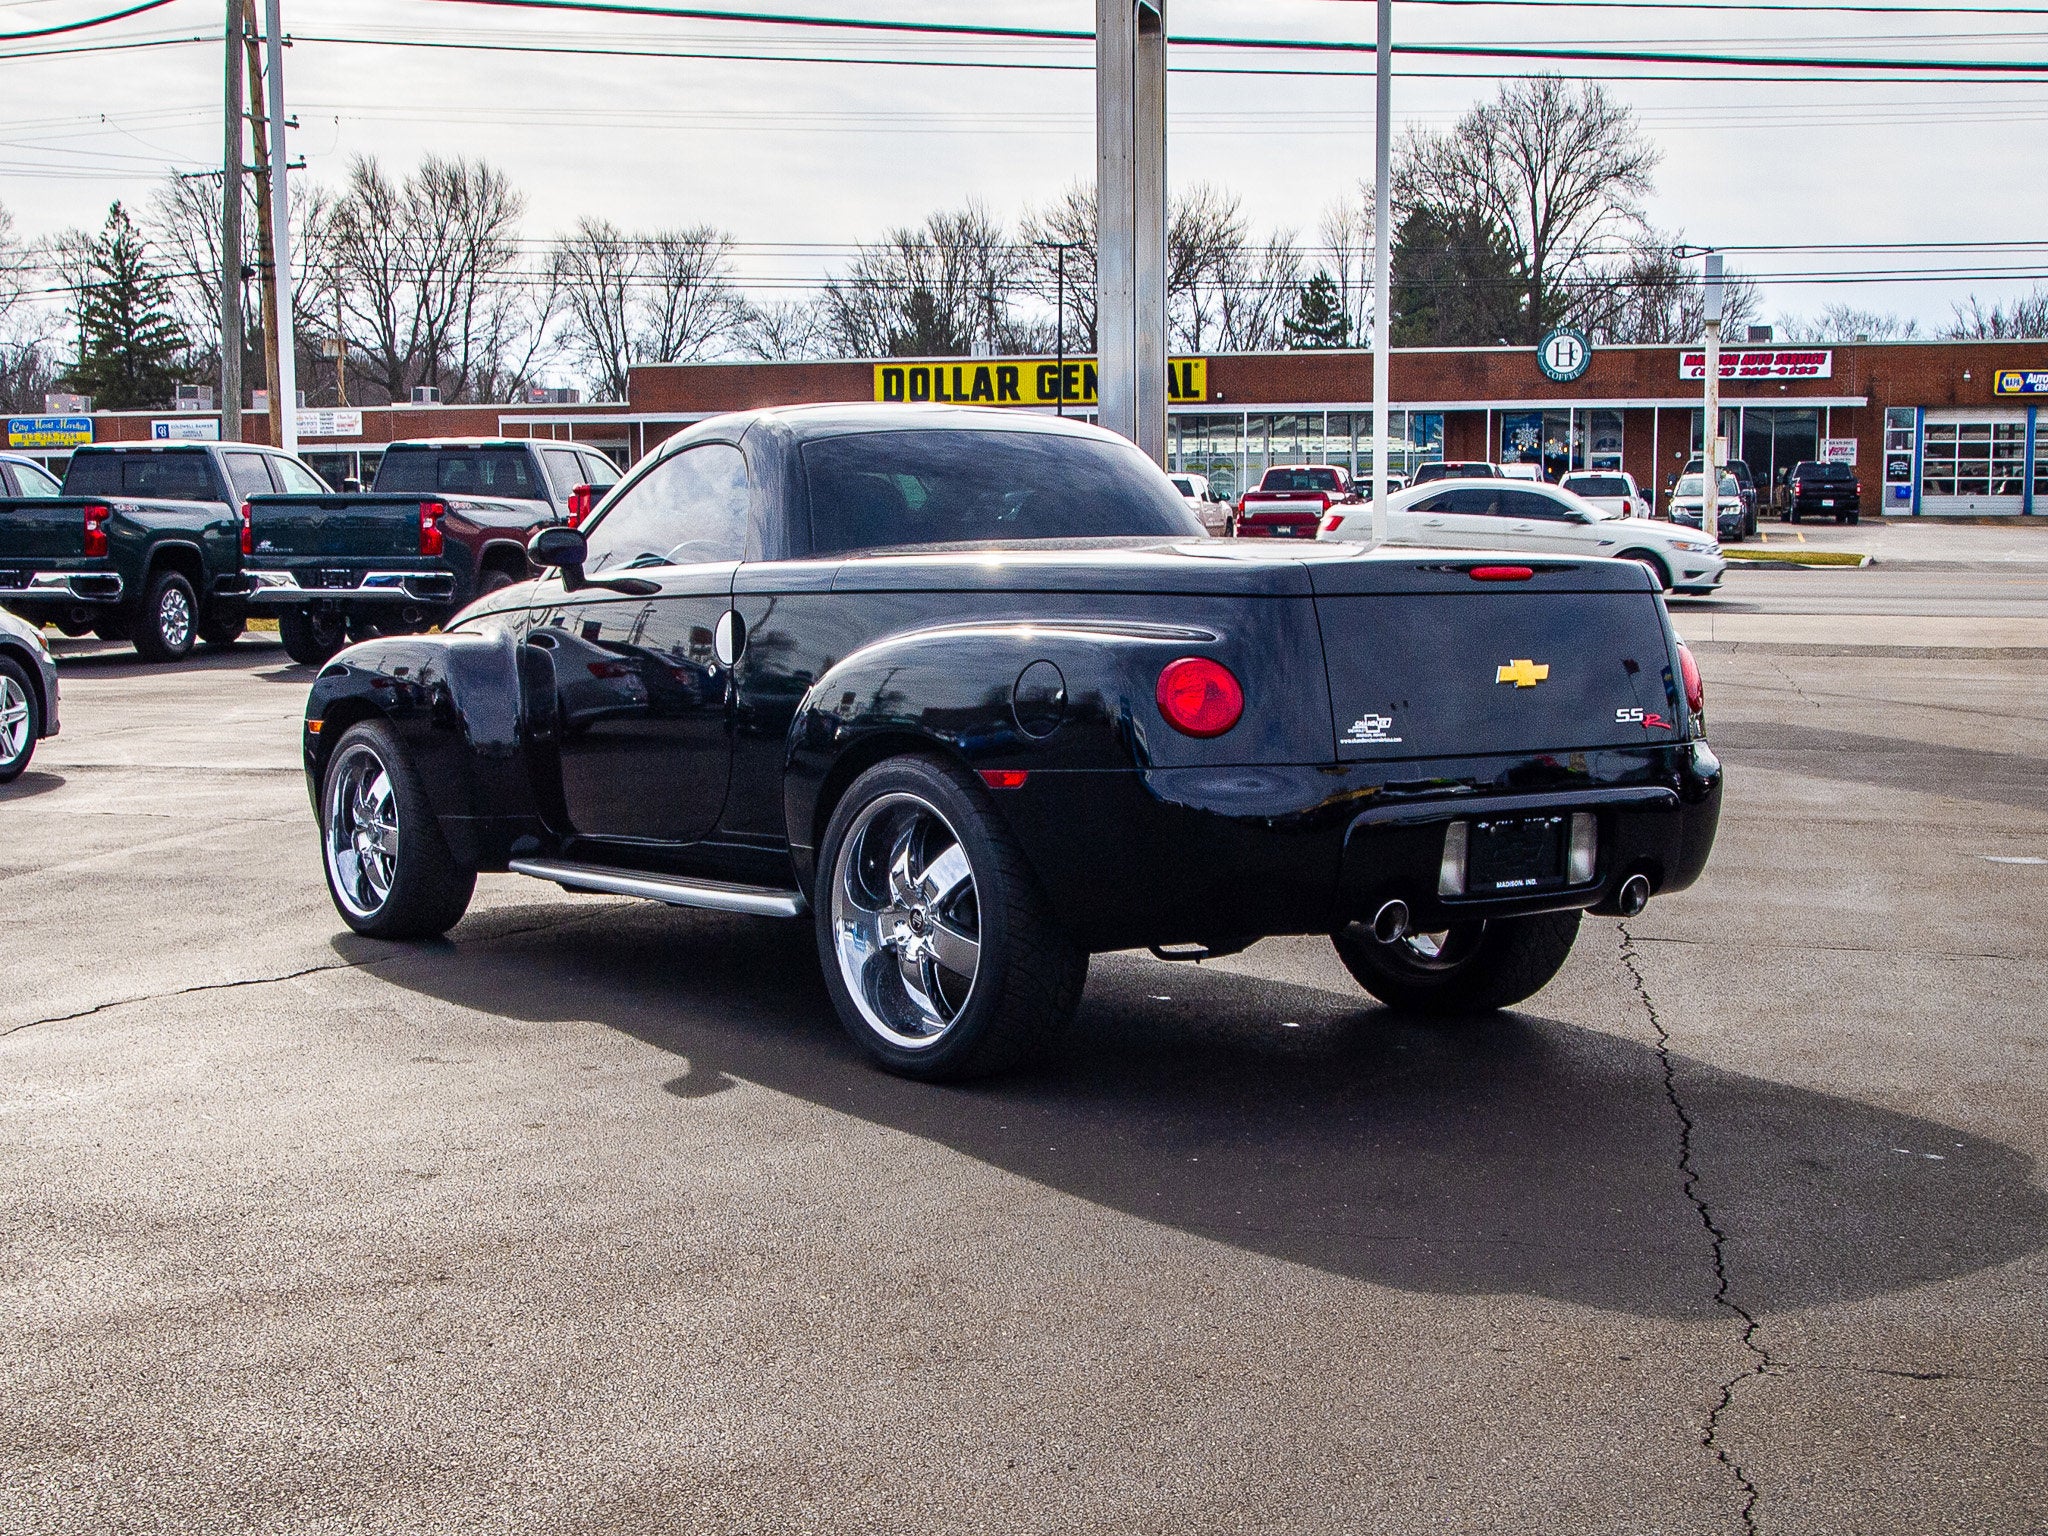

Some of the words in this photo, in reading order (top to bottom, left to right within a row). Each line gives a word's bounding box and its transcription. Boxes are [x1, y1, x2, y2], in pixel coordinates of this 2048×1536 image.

[1741, 354, 1774, 365] AUTO
[1774, 353, 1827, 365] SERVICE
[882, 365, 1020, 401] DOLLAR
[1036, 361, 1200, 400] GENAL
[1546, 369, 1581, 381] COFFEE
